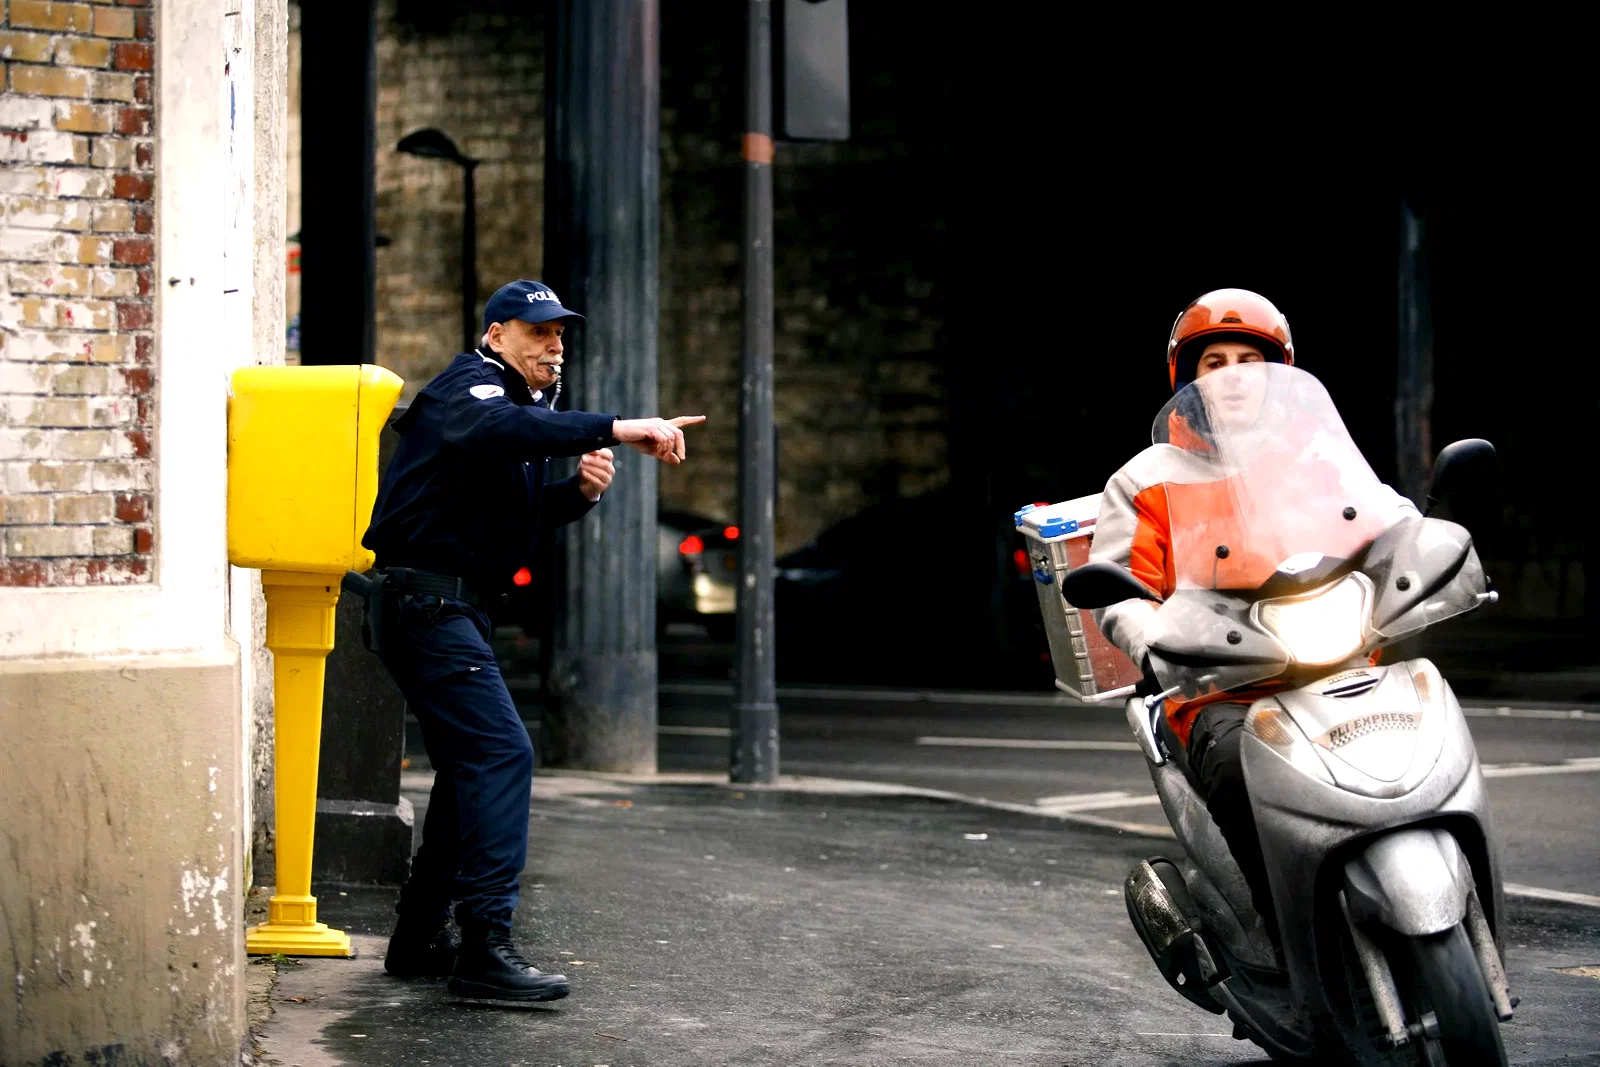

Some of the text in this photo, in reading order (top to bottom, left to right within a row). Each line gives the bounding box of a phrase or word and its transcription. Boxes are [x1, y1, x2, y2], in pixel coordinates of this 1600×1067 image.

[527, 290, 561, 305] POLI
[1329, 713, 1414, 742] PLI EXPRESS
